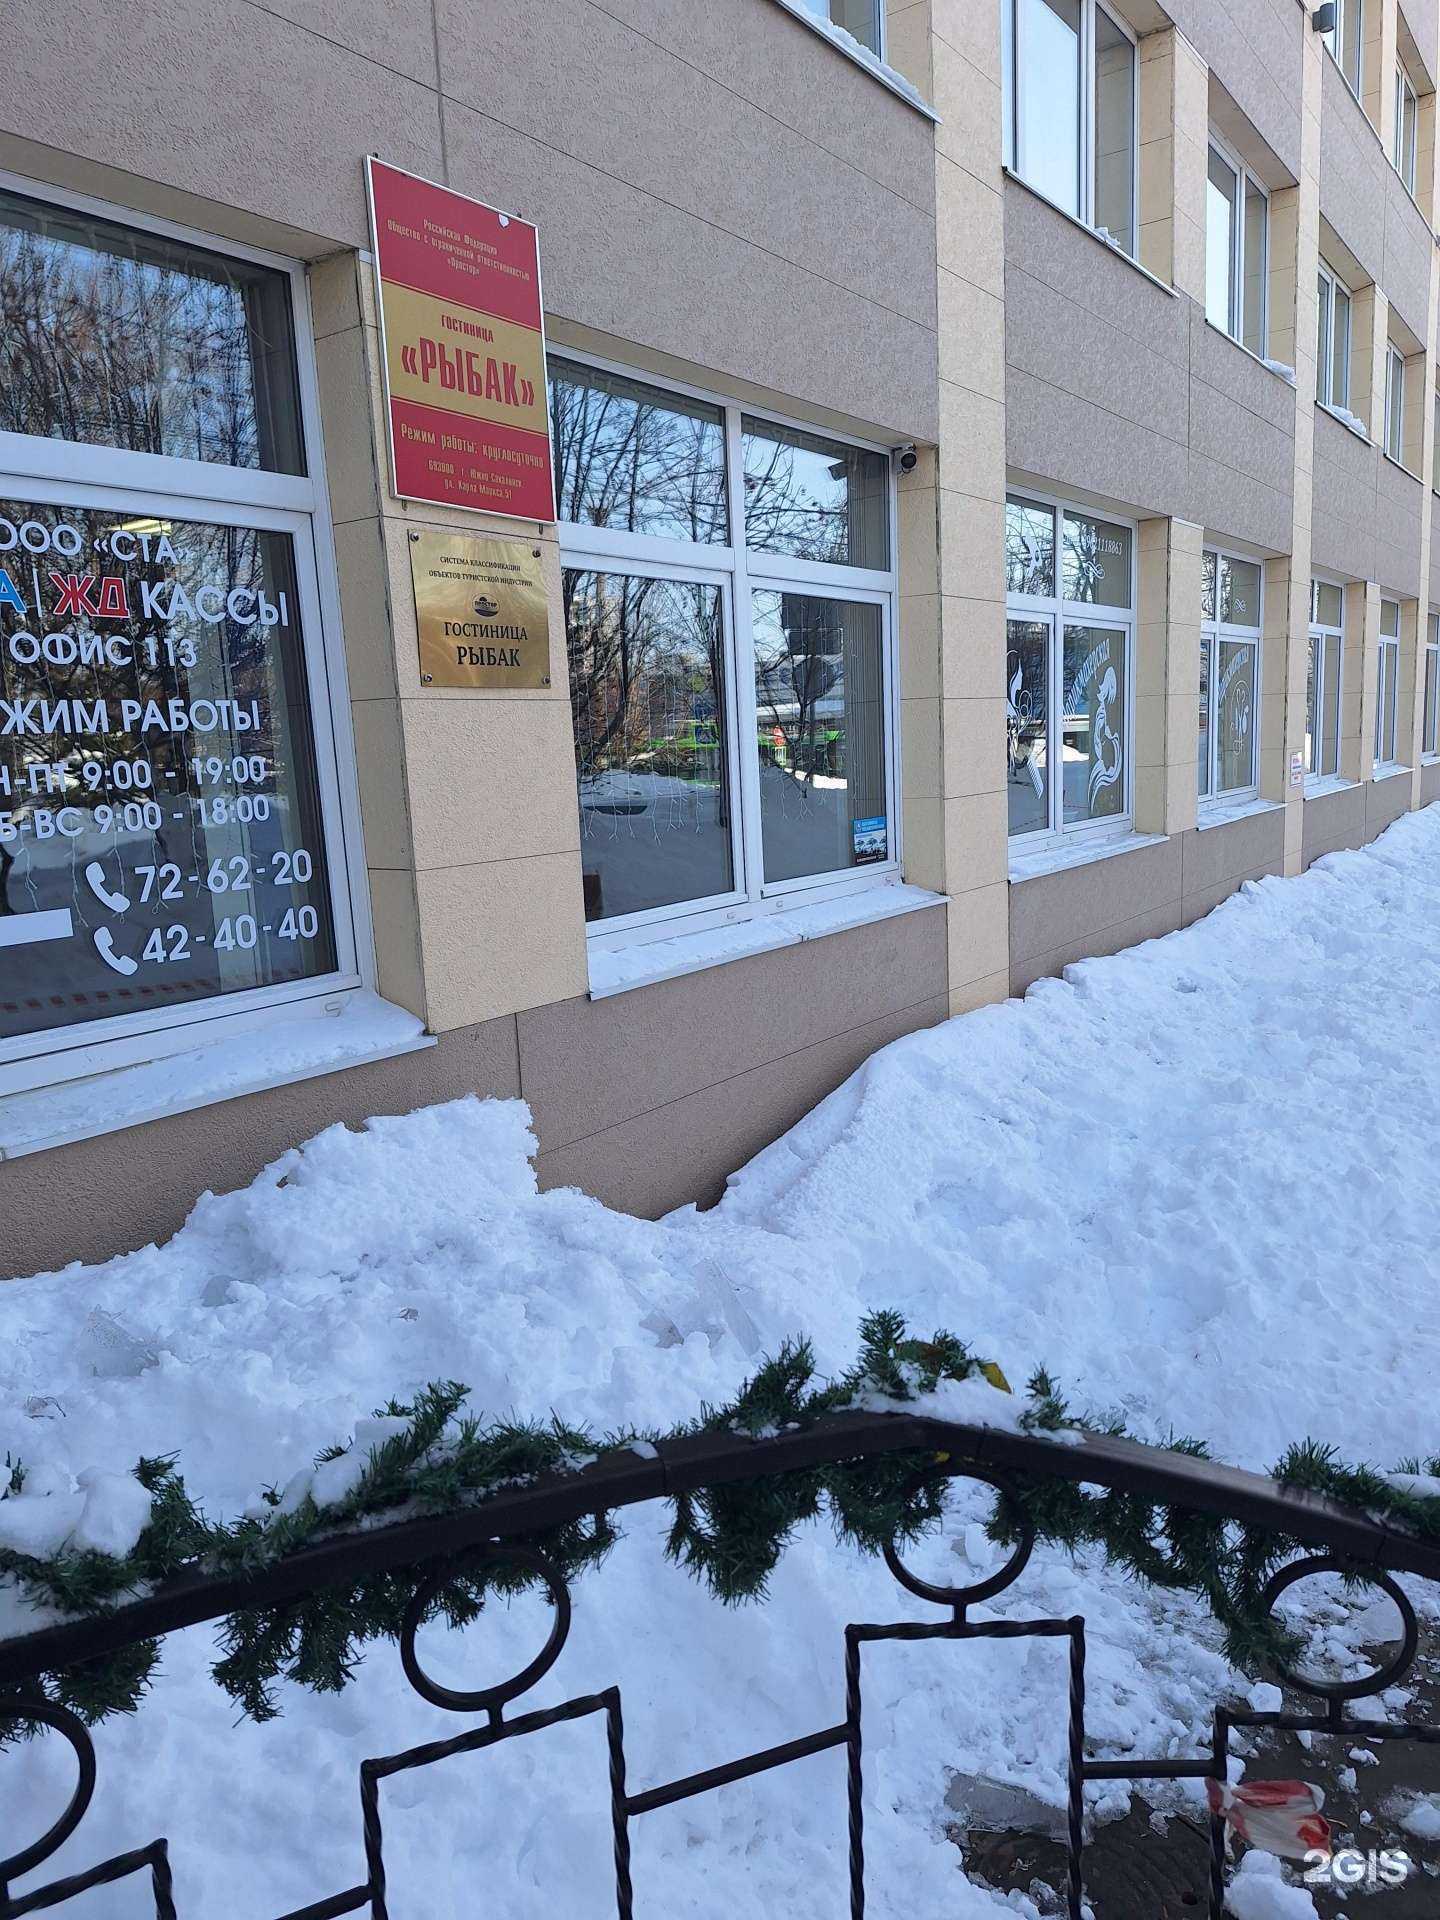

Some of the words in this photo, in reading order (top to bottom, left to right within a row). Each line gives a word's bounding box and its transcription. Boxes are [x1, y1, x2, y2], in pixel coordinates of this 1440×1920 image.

[387, 219, 421, 241] Общество
[441, 314, 494, 343] ГОСТИНИЦА
[401, 337, 535, 407] «РЫБАК»
[400, 423, 436, 445] Режим
[441, 434, 478, 454] работы:
[482, 444, 544, 468] круглосуточно
[0, 517, 82, 556] ООО
[428, 569, 461, 580] ОБЪЕКТОВ
[462, 573, 500, 584] ТУРИСТСКОЙ
[500, 576, 533, 587] ИНДУСТРИИ
[439, 556, 469, 566] СИСТЕМА
[470, 559, 521, 572] КЛАССИФИКАЦИИ
[48, 572, 131, 619] ЖД
[140, 580, 289, 627] КАССЫ
[9, 630, 133, 667] ОФИС
[144, 634, 198, 668] 113
[444, 621, 528, 644] ГОСТИНИЦА
[456, 645, 521, 667] РЫБАК
[121, 697, 261, 734] РАБОТЫ
[82, 758, 152, 792] 9:00
[191, 755, 267, 786] 19:00
[93, 800, 162, 835] 9:00
[196, 793, 270, 827] 18:00
